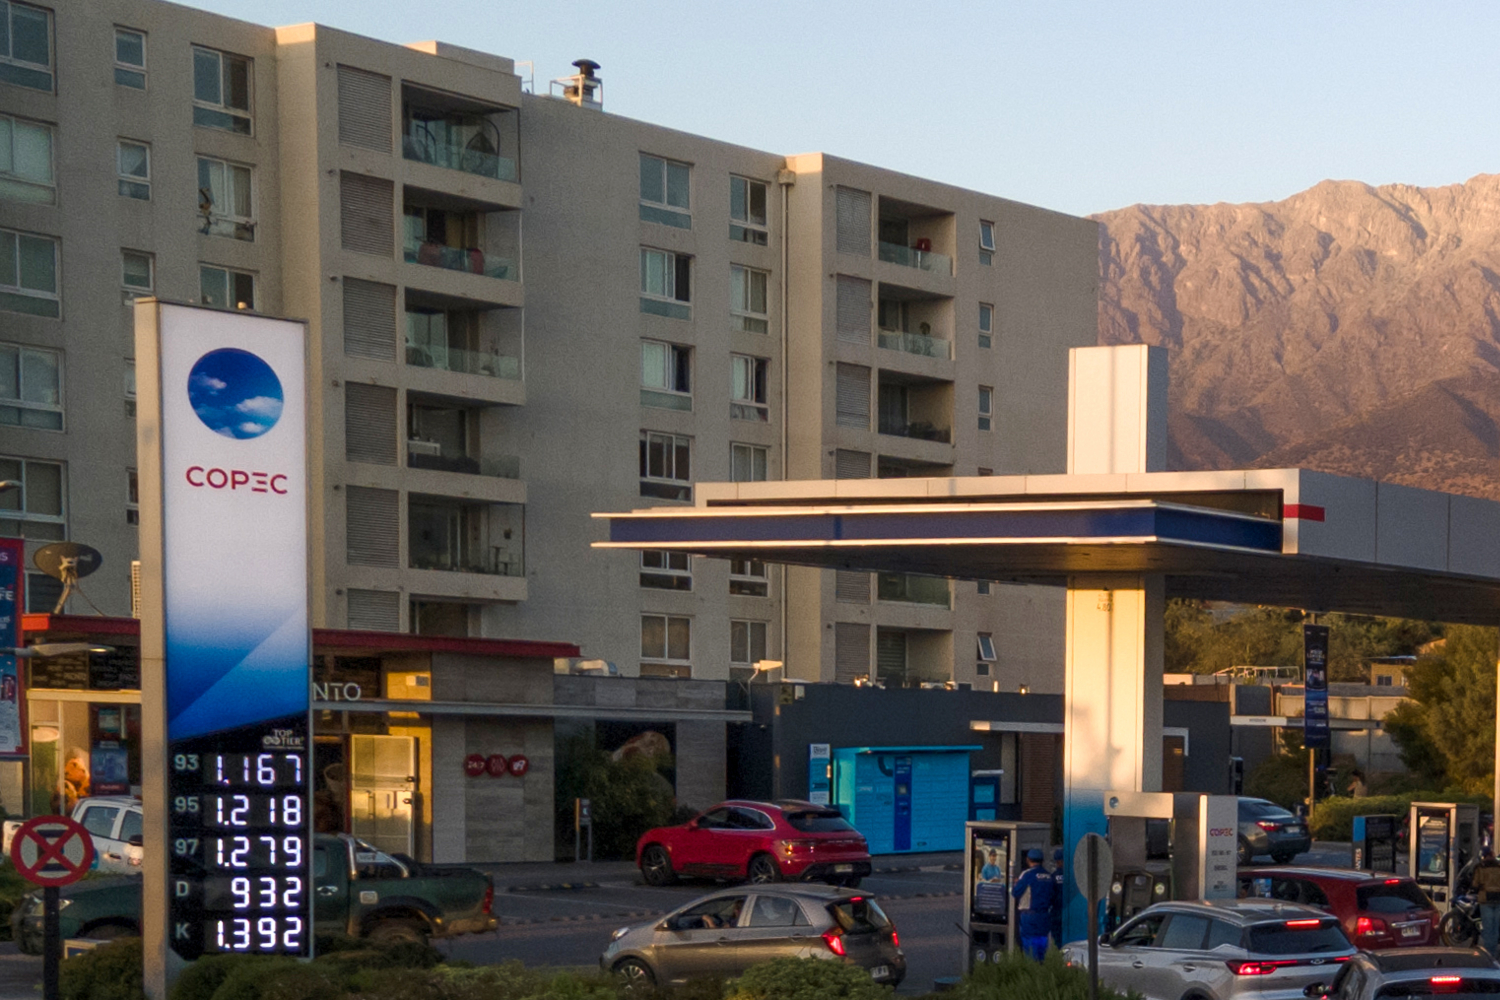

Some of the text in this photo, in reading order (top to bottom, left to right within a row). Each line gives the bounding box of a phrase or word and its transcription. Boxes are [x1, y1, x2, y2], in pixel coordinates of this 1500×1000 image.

[185, 466, 288, 495] COPEC
[312, 682, 361, 701] NTO
[175, 754, 301, 784] 93 1.167
[175, 796, 301, 825] 95 1.218
[175, 837, 301, 867] 97 1.279
[176, 878, 301, 907] D 932
[176, 917, 301, 948] K 1.392
